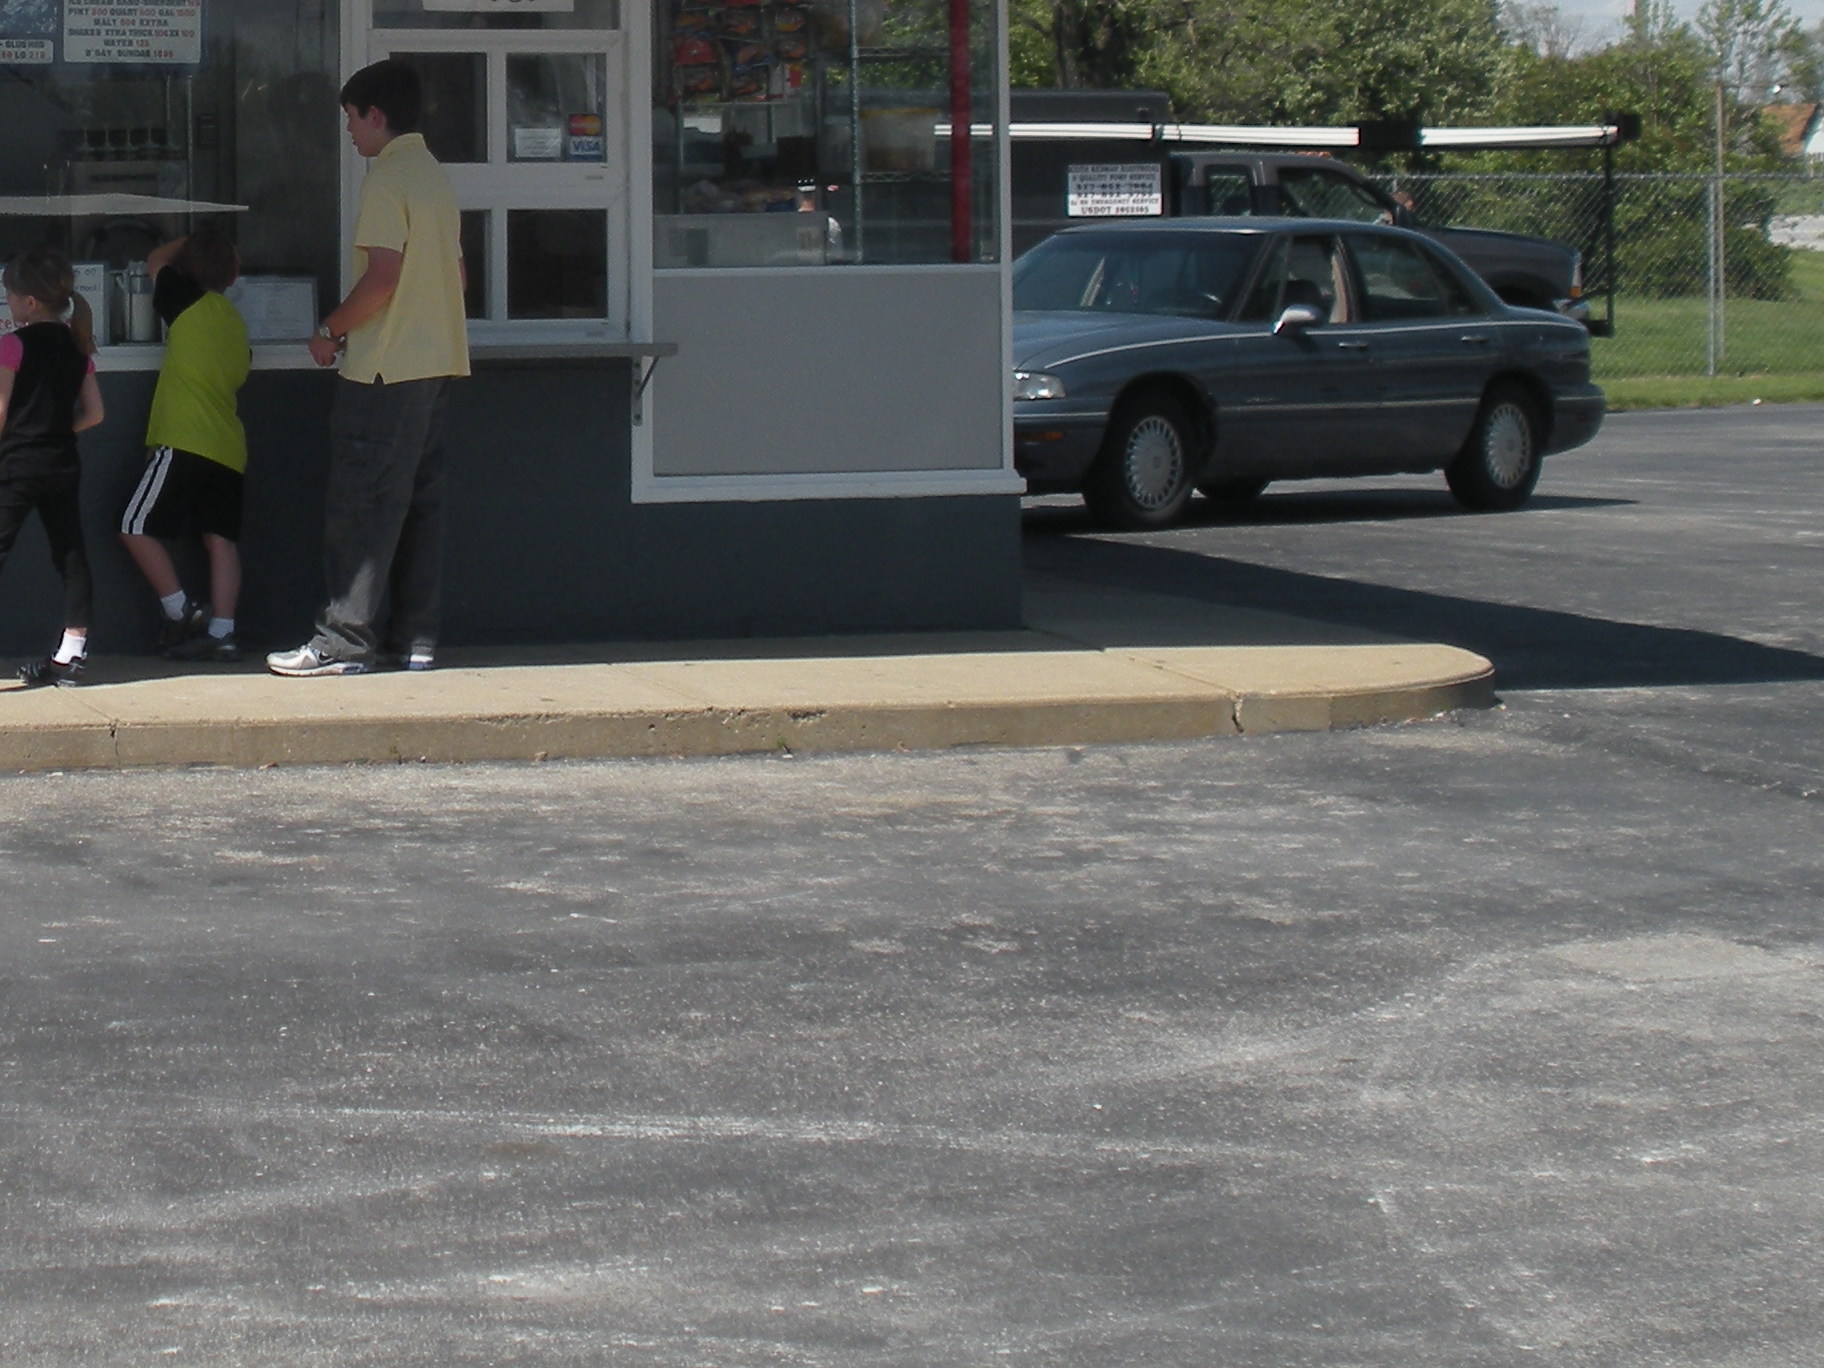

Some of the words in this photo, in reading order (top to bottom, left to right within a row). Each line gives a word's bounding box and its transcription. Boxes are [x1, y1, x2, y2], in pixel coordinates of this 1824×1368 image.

[68, 8, 88, 16] PINT
[93, 18, 116, 26] MALT
[139, 18, 167, 26] EXTRA
[104, 39, 133, 47] WATER
[571, 141, 602, 152] VISA
